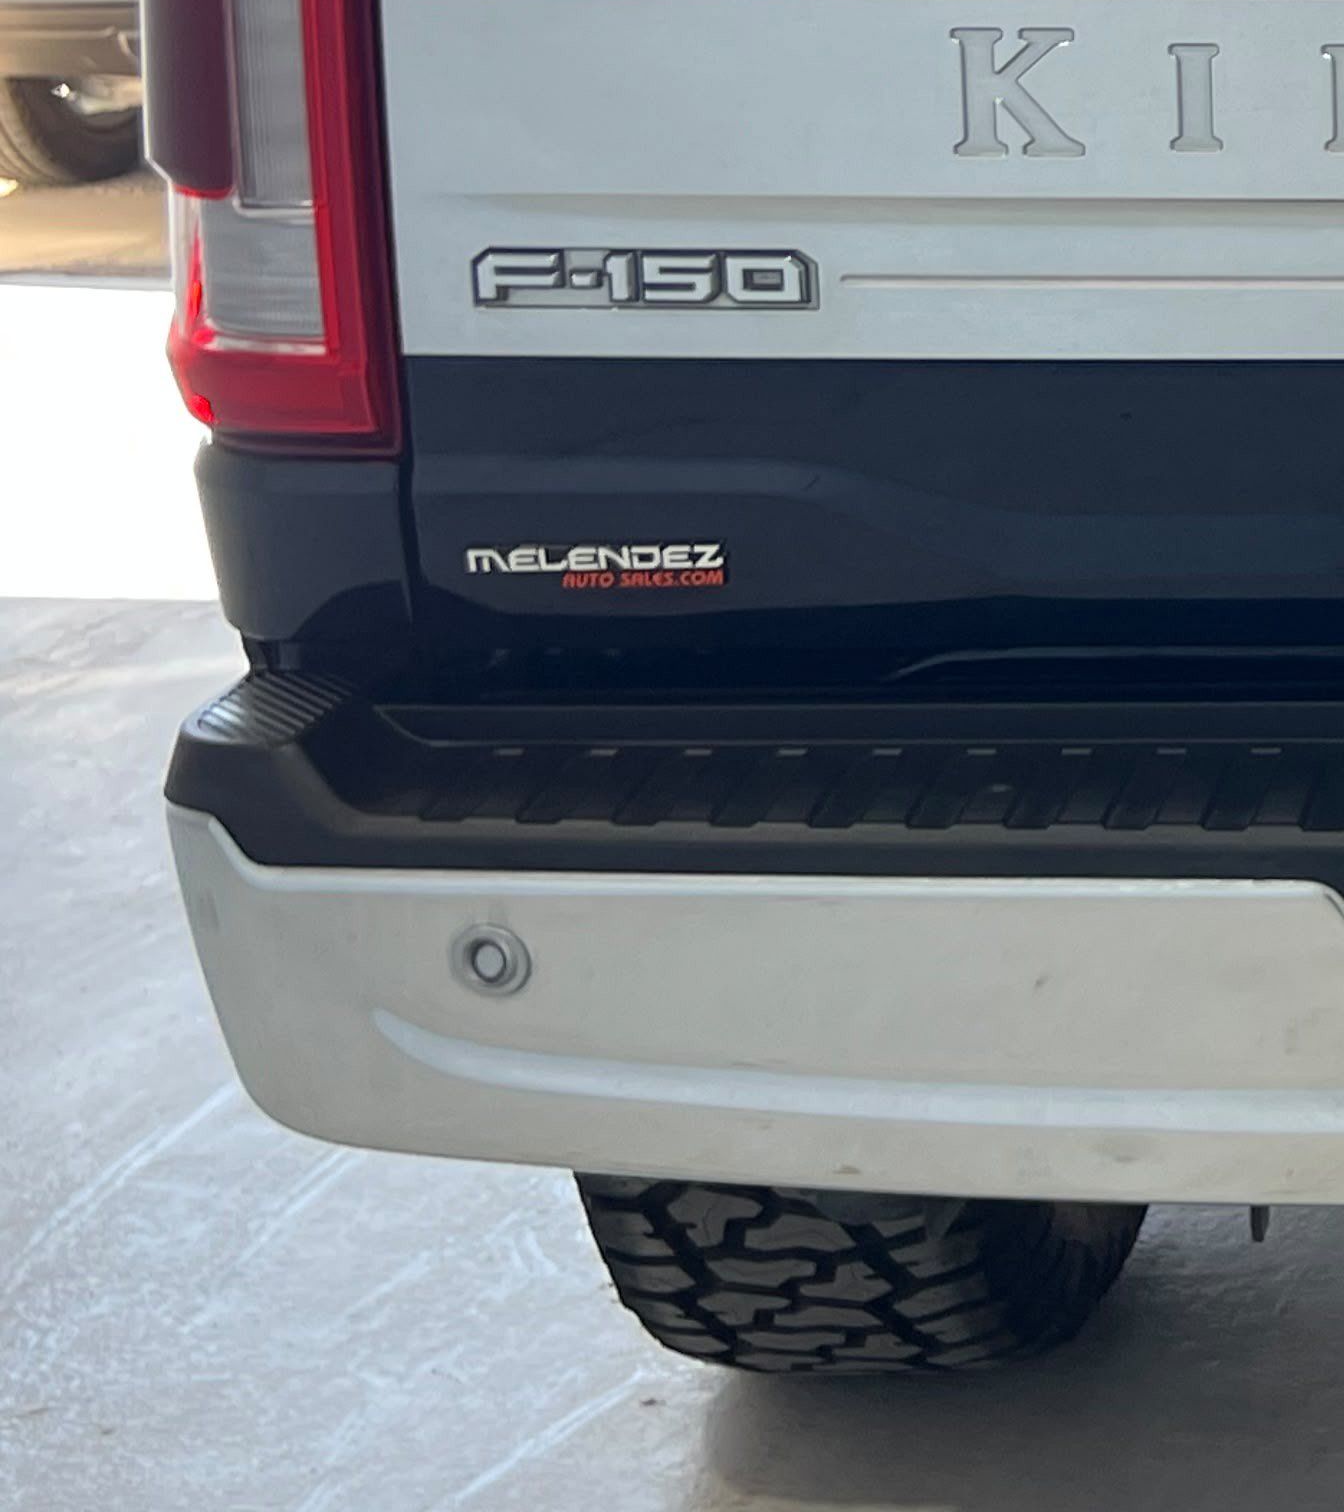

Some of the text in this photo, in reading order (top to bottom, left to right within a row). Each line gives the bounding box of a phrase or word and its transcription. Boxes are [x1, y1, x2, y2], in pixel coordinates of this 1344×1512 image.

[472, 247, 815, 307] F-150
[466, 543, 725, 573] MELENDEZ
[562, 569, 725, 588] AUTO SALES.COM
